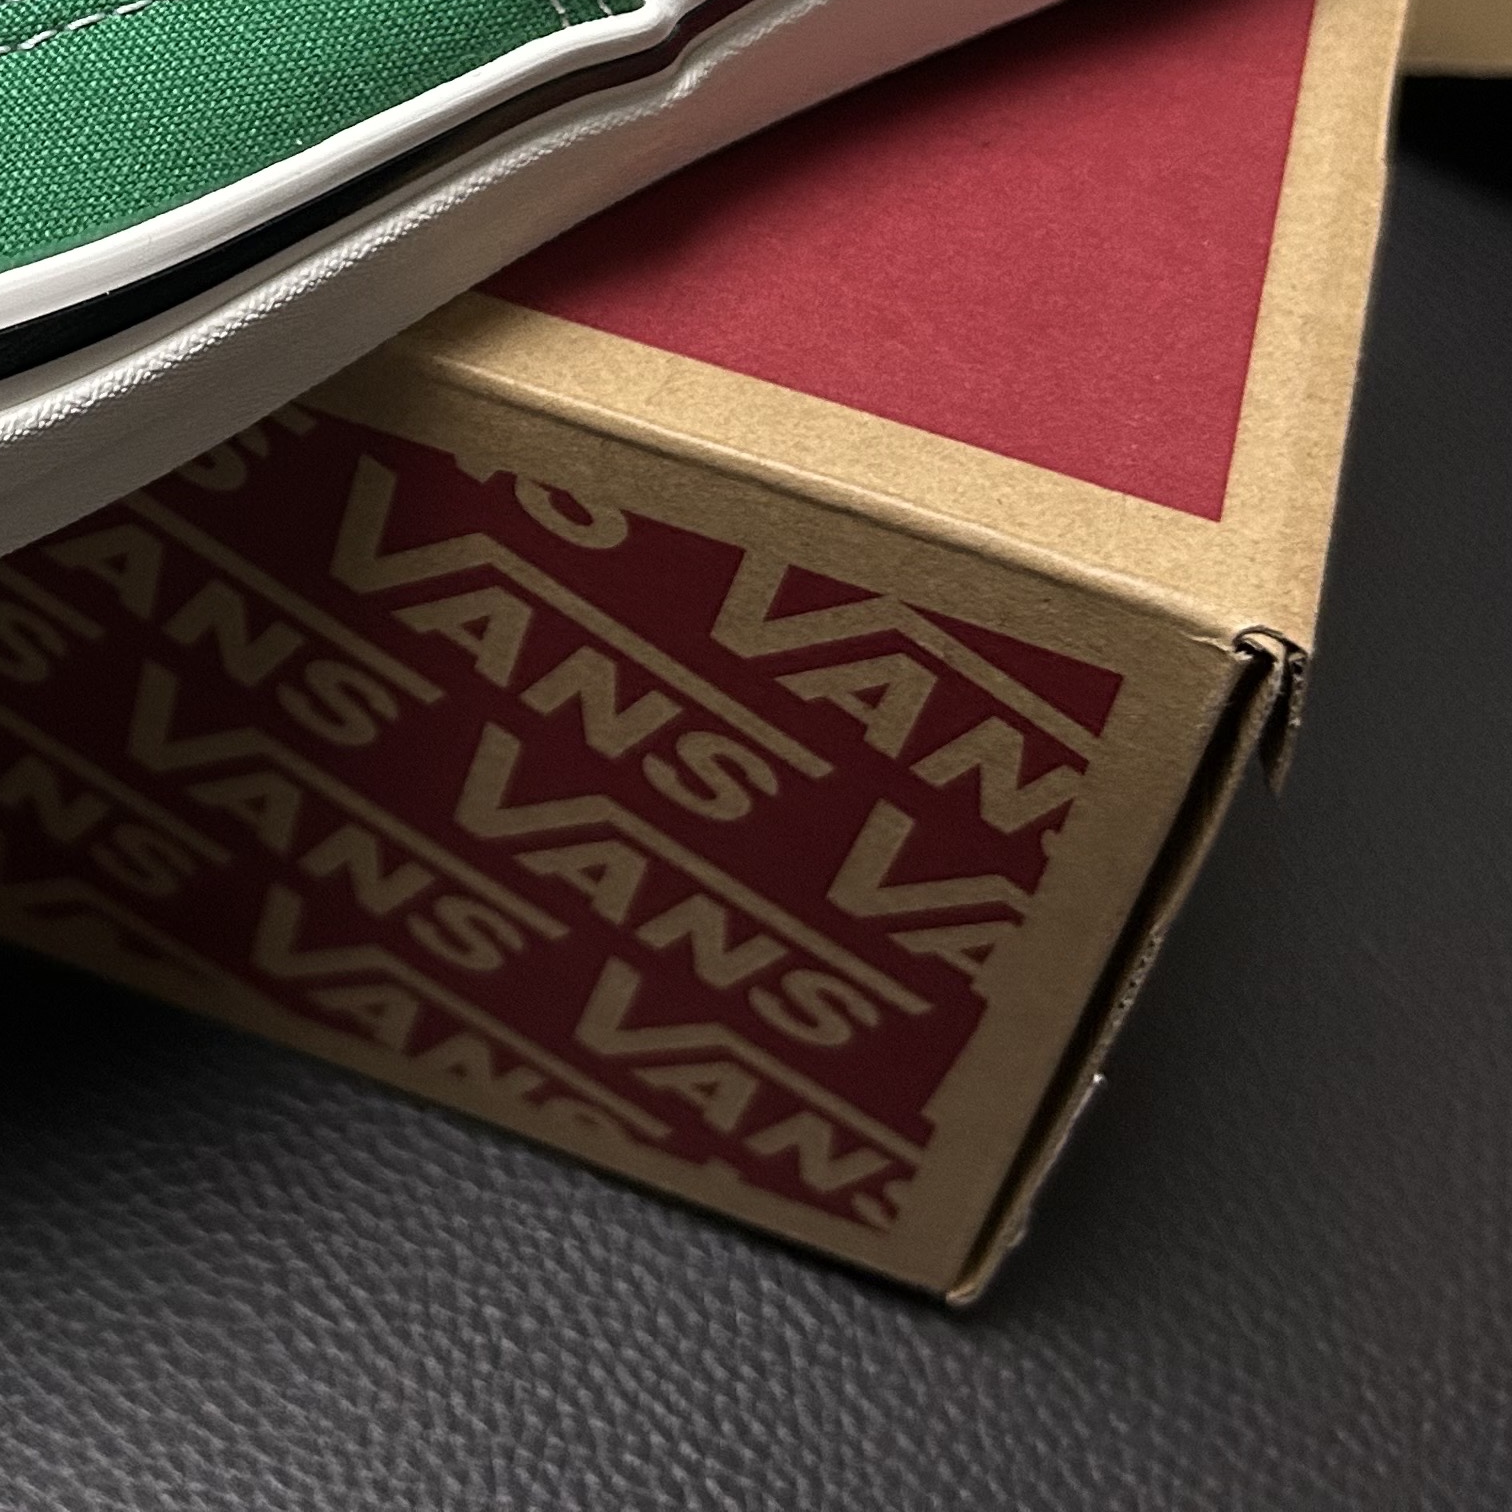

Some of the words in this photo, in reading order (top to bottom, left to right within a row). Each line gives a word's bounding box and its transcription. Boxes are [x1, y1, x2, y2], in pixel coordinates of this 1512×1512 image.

[42, 491, 446, 748] ANS
[329, 454, 833, 823] VANS
[710, 550, 1100, 860] VAN
[129, 658, 570, 972] VANS
[453, 721, 934, 1047] VANS
